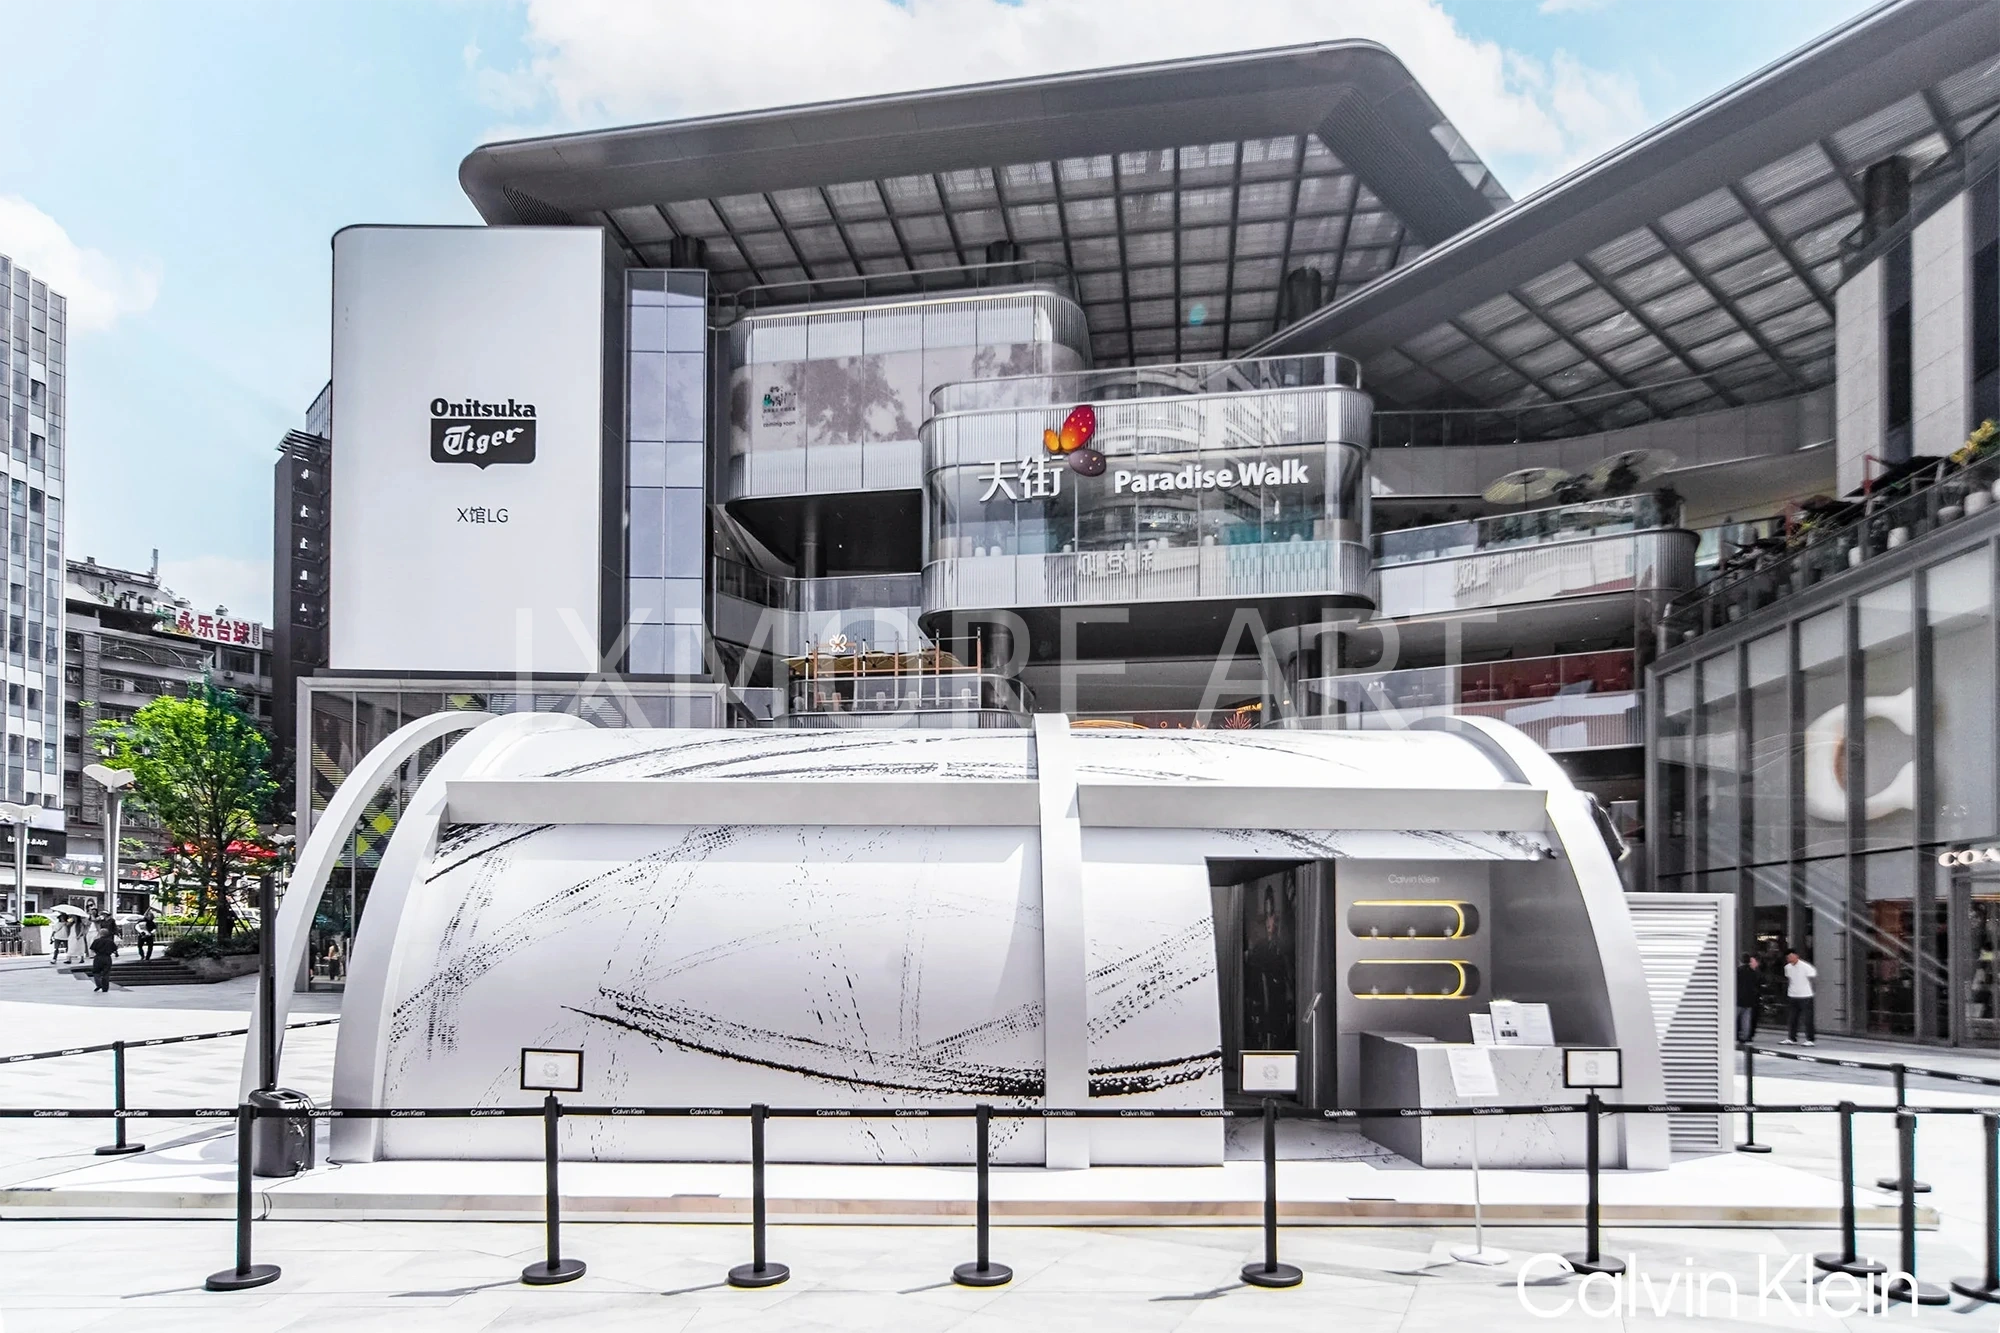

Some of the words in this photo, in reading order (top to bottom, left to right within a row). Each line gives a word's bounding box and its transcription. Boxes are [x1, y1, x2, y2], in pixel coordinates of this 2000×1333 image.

[430, 398, 536, 417] Onitsuka
[442, 424, 525, 456] Tiger
[978, 455, 1064, 502] 天街
[1114, 464, 1233, 494] Paradise
[1237, 459, 1309, 487] Walk
[456, 505, 509, 524] X馆LG
[177, 610, 250, 645] 永乐台球
[1388, 873, 1417, 884] Calvin
[1418, 874, 1440, 884] Klein
[308, 1109, 327, 1117] Calvin
[328, 1109, 343, 1117] Klein
[390, 1109, 409, 1117] Calvin
[409, 1109, 425, 1117] Klein
[611, 1107, 630, 1115] Calvin
[630, 1107, 645, 1115] Klein
[689, 1107, 708, 1115] Calvin
[708, 1107, 723, 1115] Klein
